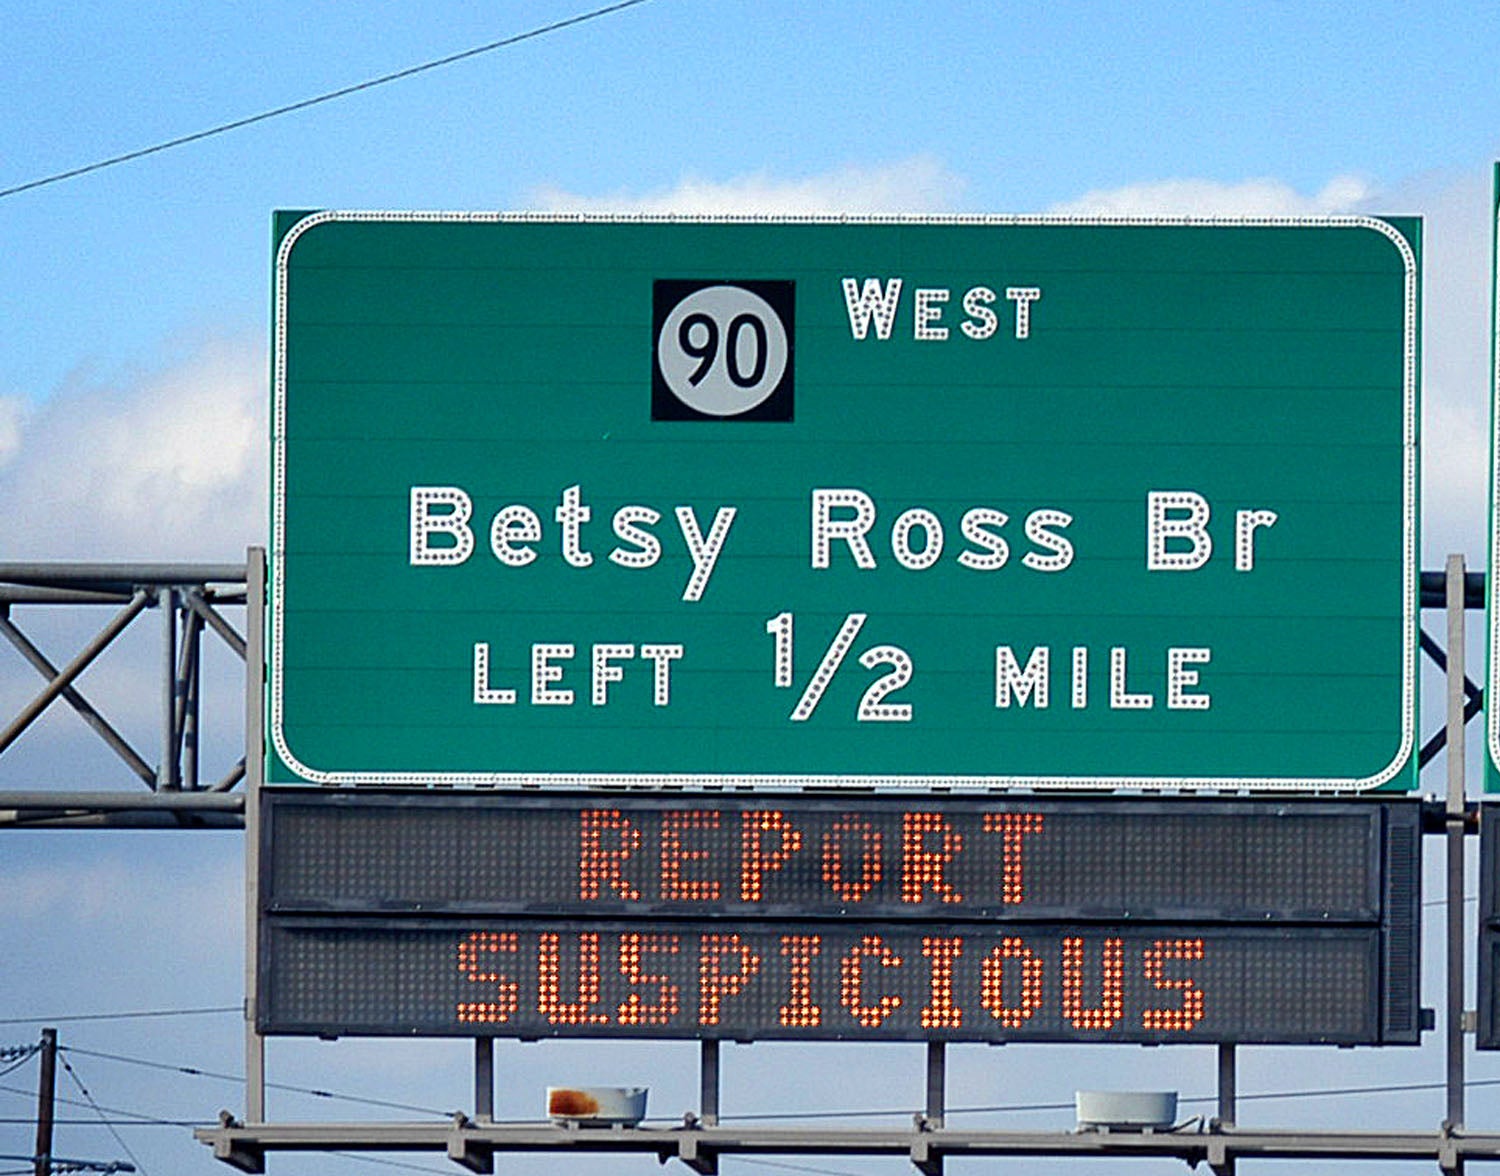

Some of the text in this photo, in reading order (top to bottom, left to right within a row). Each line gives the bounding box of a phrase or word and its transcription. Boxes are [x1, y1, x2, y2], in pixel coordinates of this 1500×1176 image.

[675, 311, 770, 390] 90
[840, 276, 1043, 342] WEST
[408, 484, 1281, 603] Betsy Ross Br
[471, 610, 1213, 723] LEFT 1/2 MILE
[578, 808, 1047, 906] REPORT
[456, 930, 1208, 1034] SUSPICIOUS
